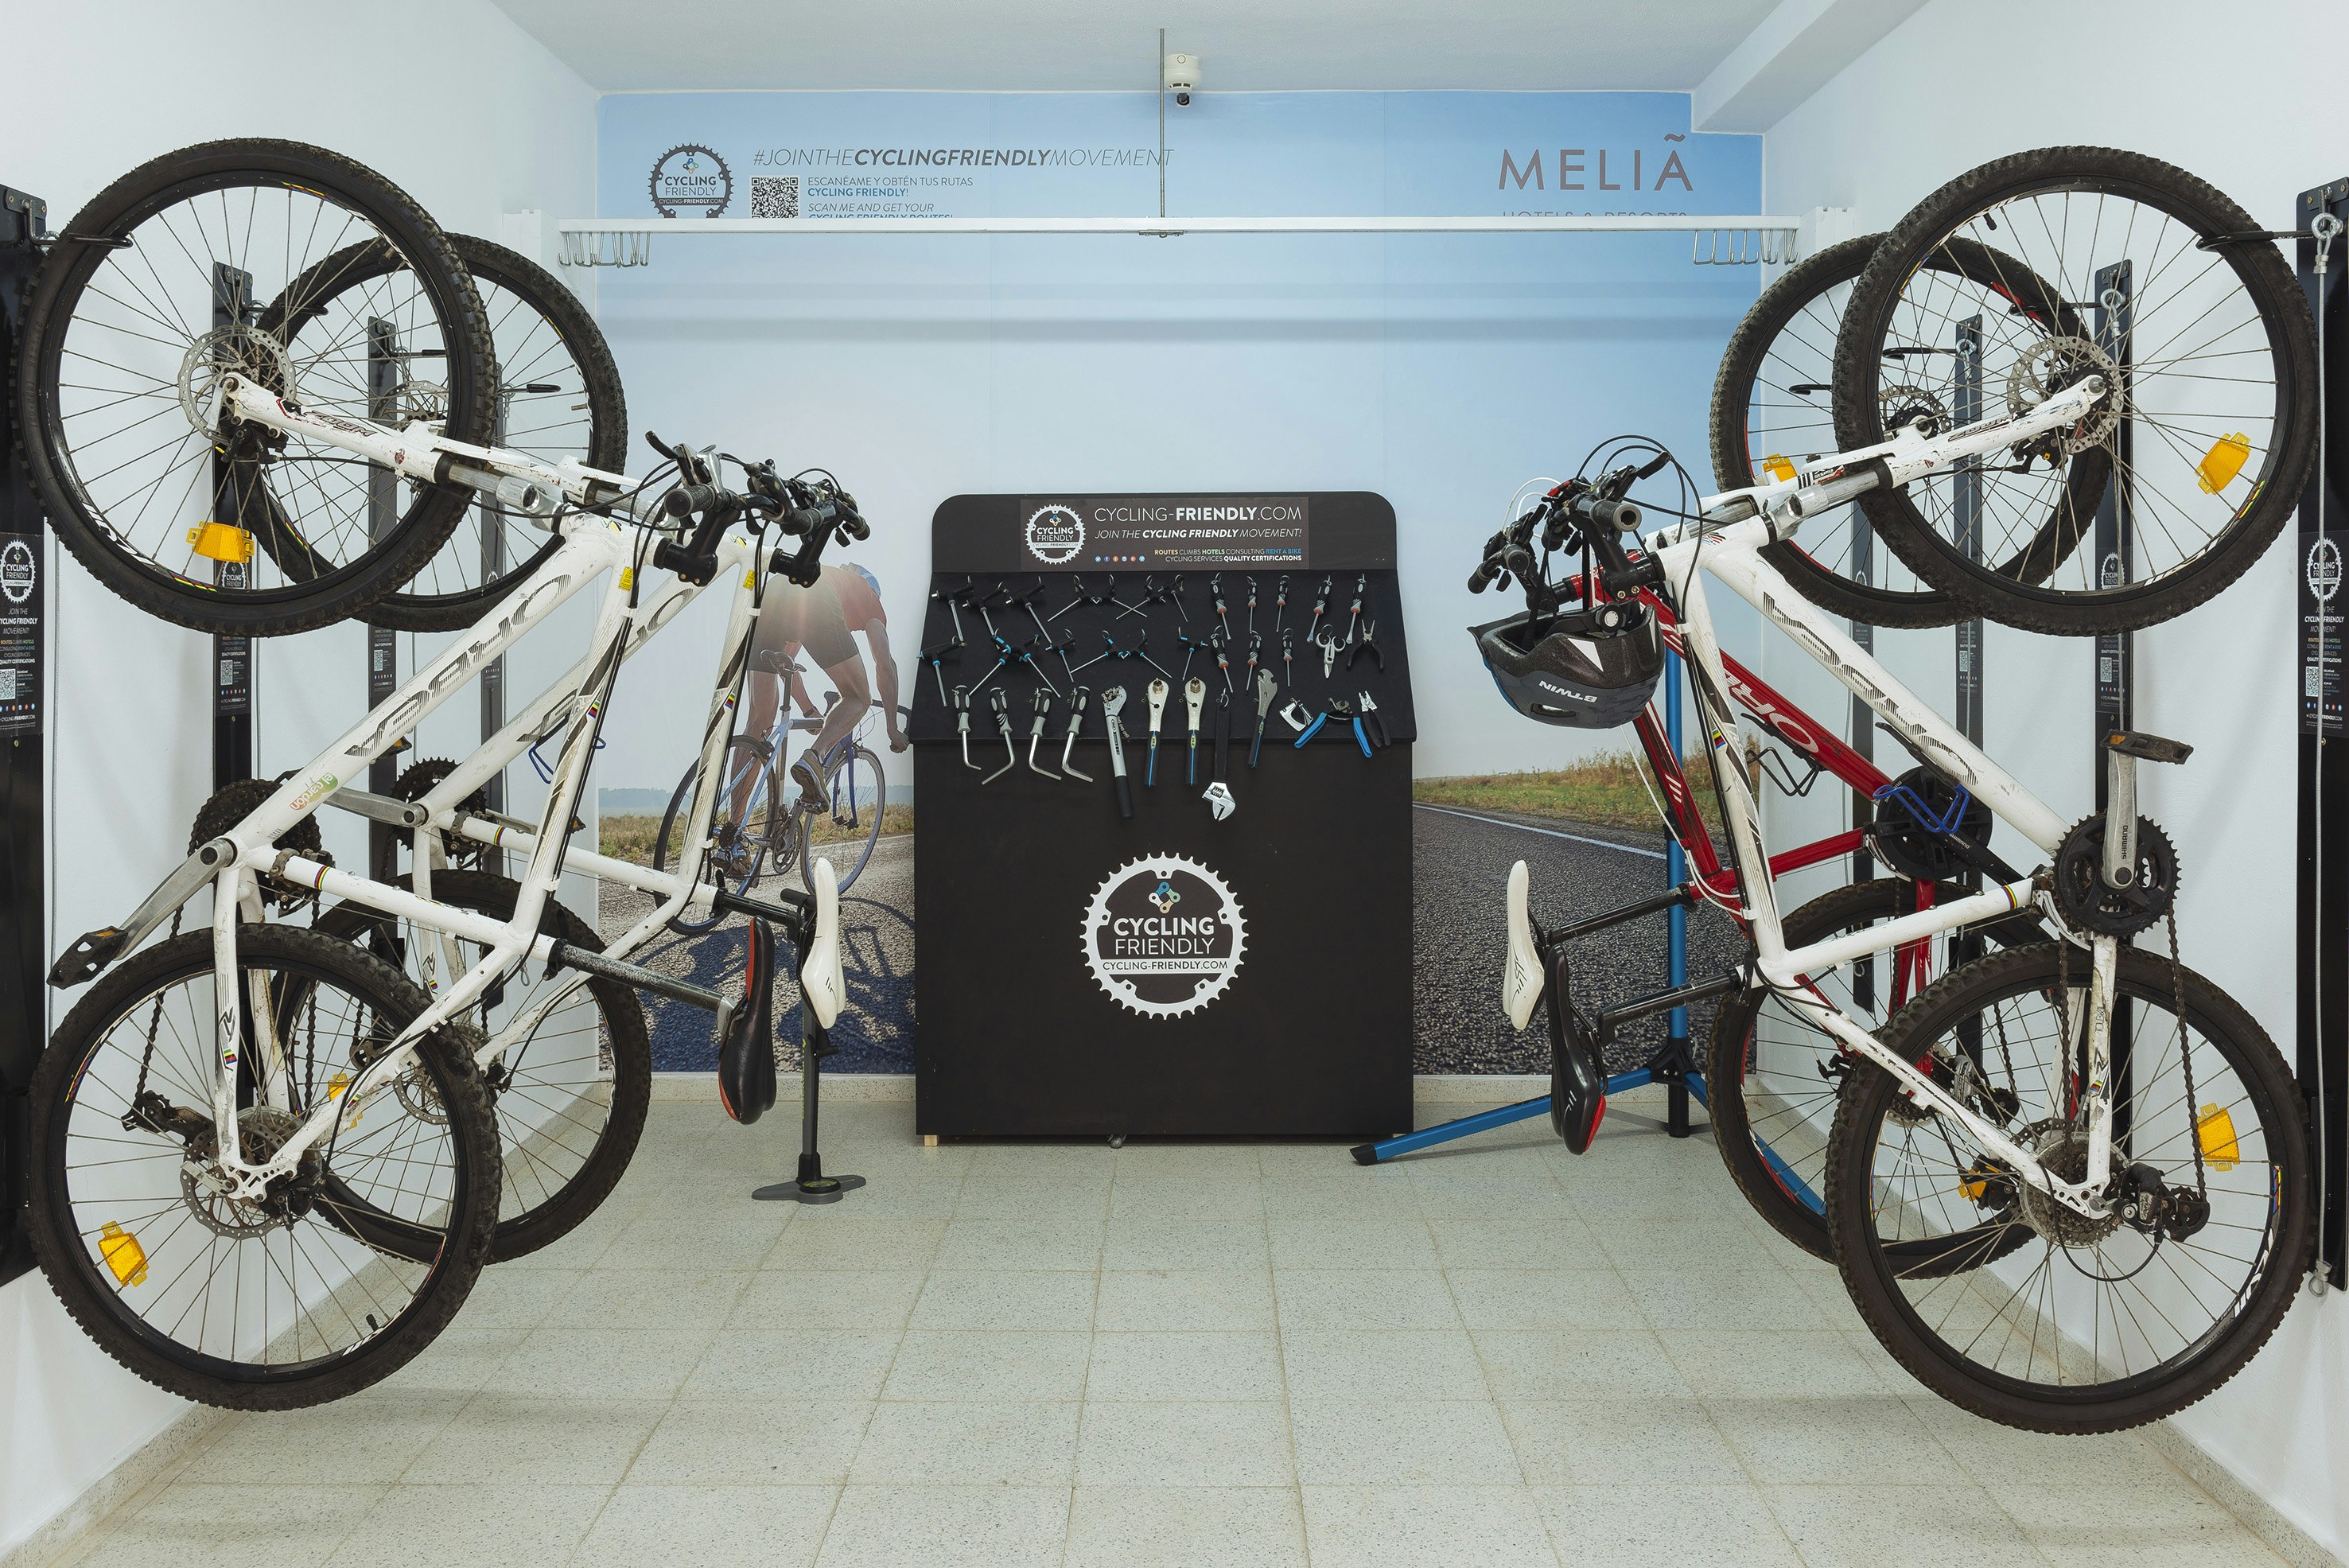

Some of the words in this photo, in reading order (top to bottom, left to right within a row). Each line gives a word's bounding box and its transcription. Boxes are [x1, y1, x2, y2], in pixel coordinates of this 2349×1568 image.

[665, 177, 716, 186] CYCLING
[808, 175, 871, 186] ESCANÉAME
[874, 177, 881, 186] Y
[882, 175, 917, 186] OBTÉN
[920, 177, 939, 186] TUS
[941, 177, 973, 186] RUTAS
[665, 187, 717, 196] FRIENDLY
[808, 188, 853, 196] CYCLING
[856, 188, 908, 196] FRIENDLY!
[808, 203, 837, 212] SCAN
[838, 203, 855, 212] ME
[857, 203, 881, 212] AND
[883, 203, 904, 212] GET
[905, 203, 935, 212] YOUR
[1094, 506, 1302, 522] CYCLING-FRIENDLY.COM
[1095, 529, 1120, 539] JOIN
[1122, 529, 1141, 539] THE
[1142, 529, 1187, 539] CYCLING
[1188, 528, 1239, 538] FRIENDLY
[1239, 528, 1302, 538] MOVEMENT!
[1114, 916, 1215, 936] CYCLING
[1115, 937, 1215, 955] FRIENDLY
[1103, 960, 1228, 971] CYCLING-FRIENDLY.COM
